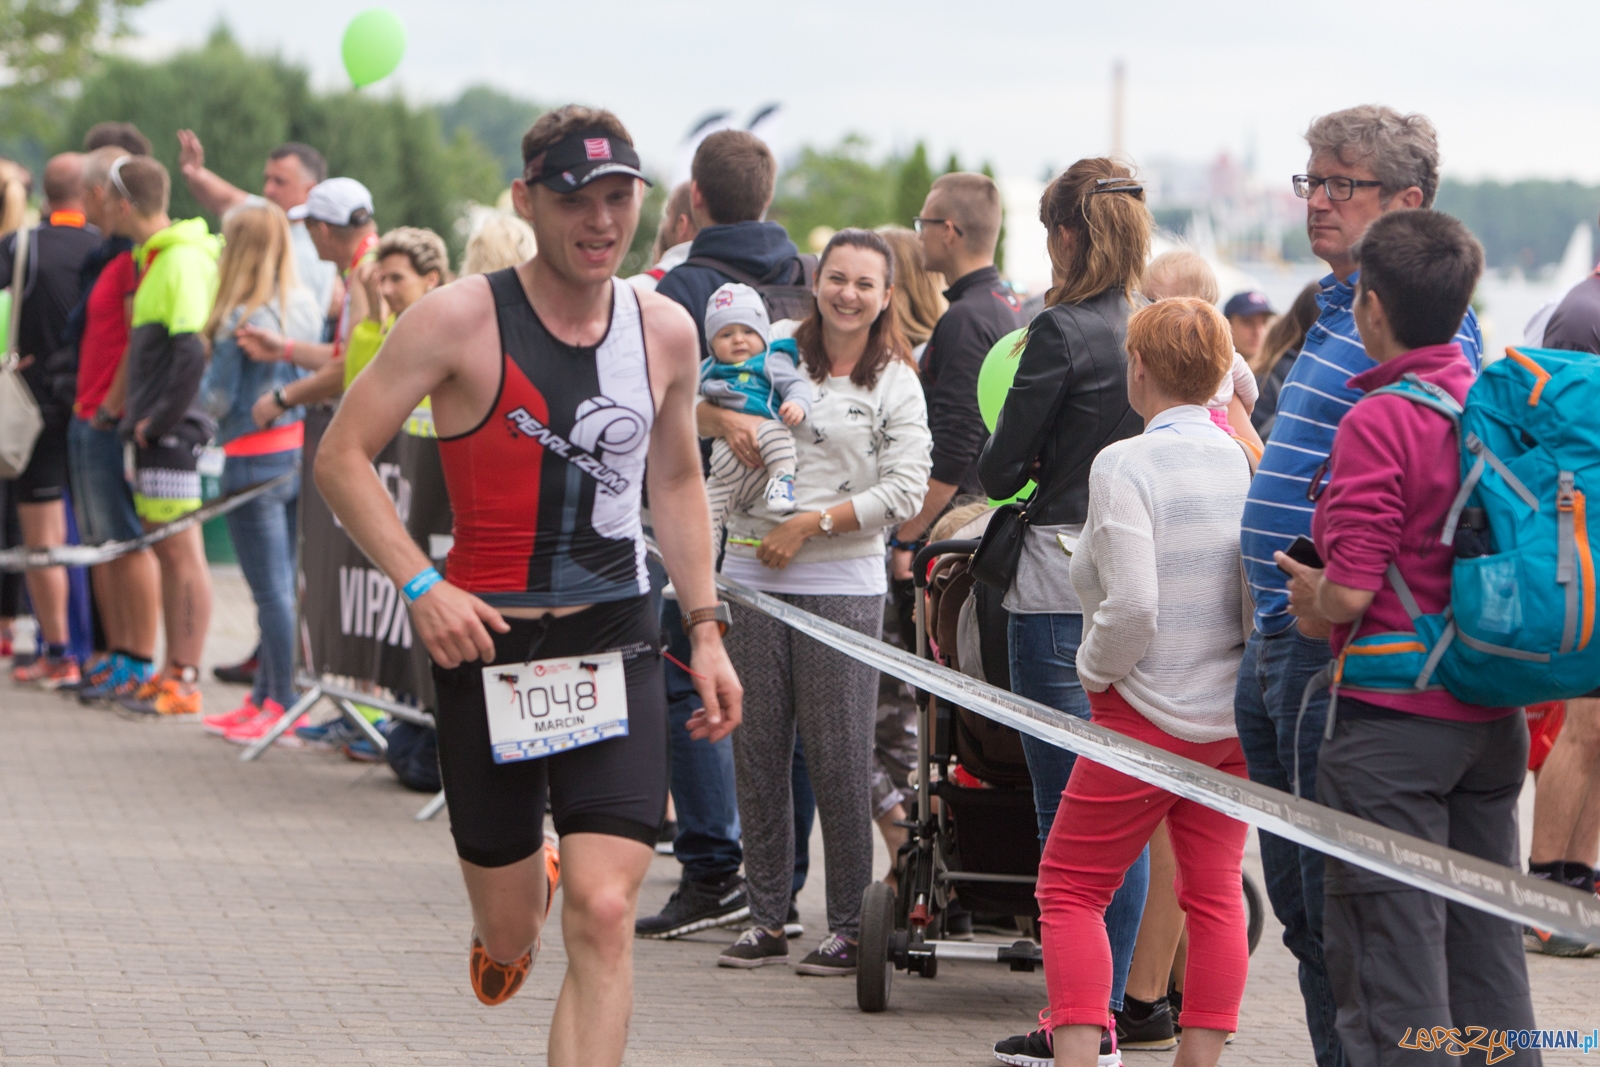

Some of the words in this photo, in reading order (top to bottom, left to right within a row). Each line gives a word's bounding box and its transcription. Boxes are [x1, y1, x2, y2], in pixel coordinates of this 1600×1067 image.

[506, 407, 571, 458] PEARL
[515, 680, 598, 720] 1048
[534, 714, 586, 733] MARCIN
